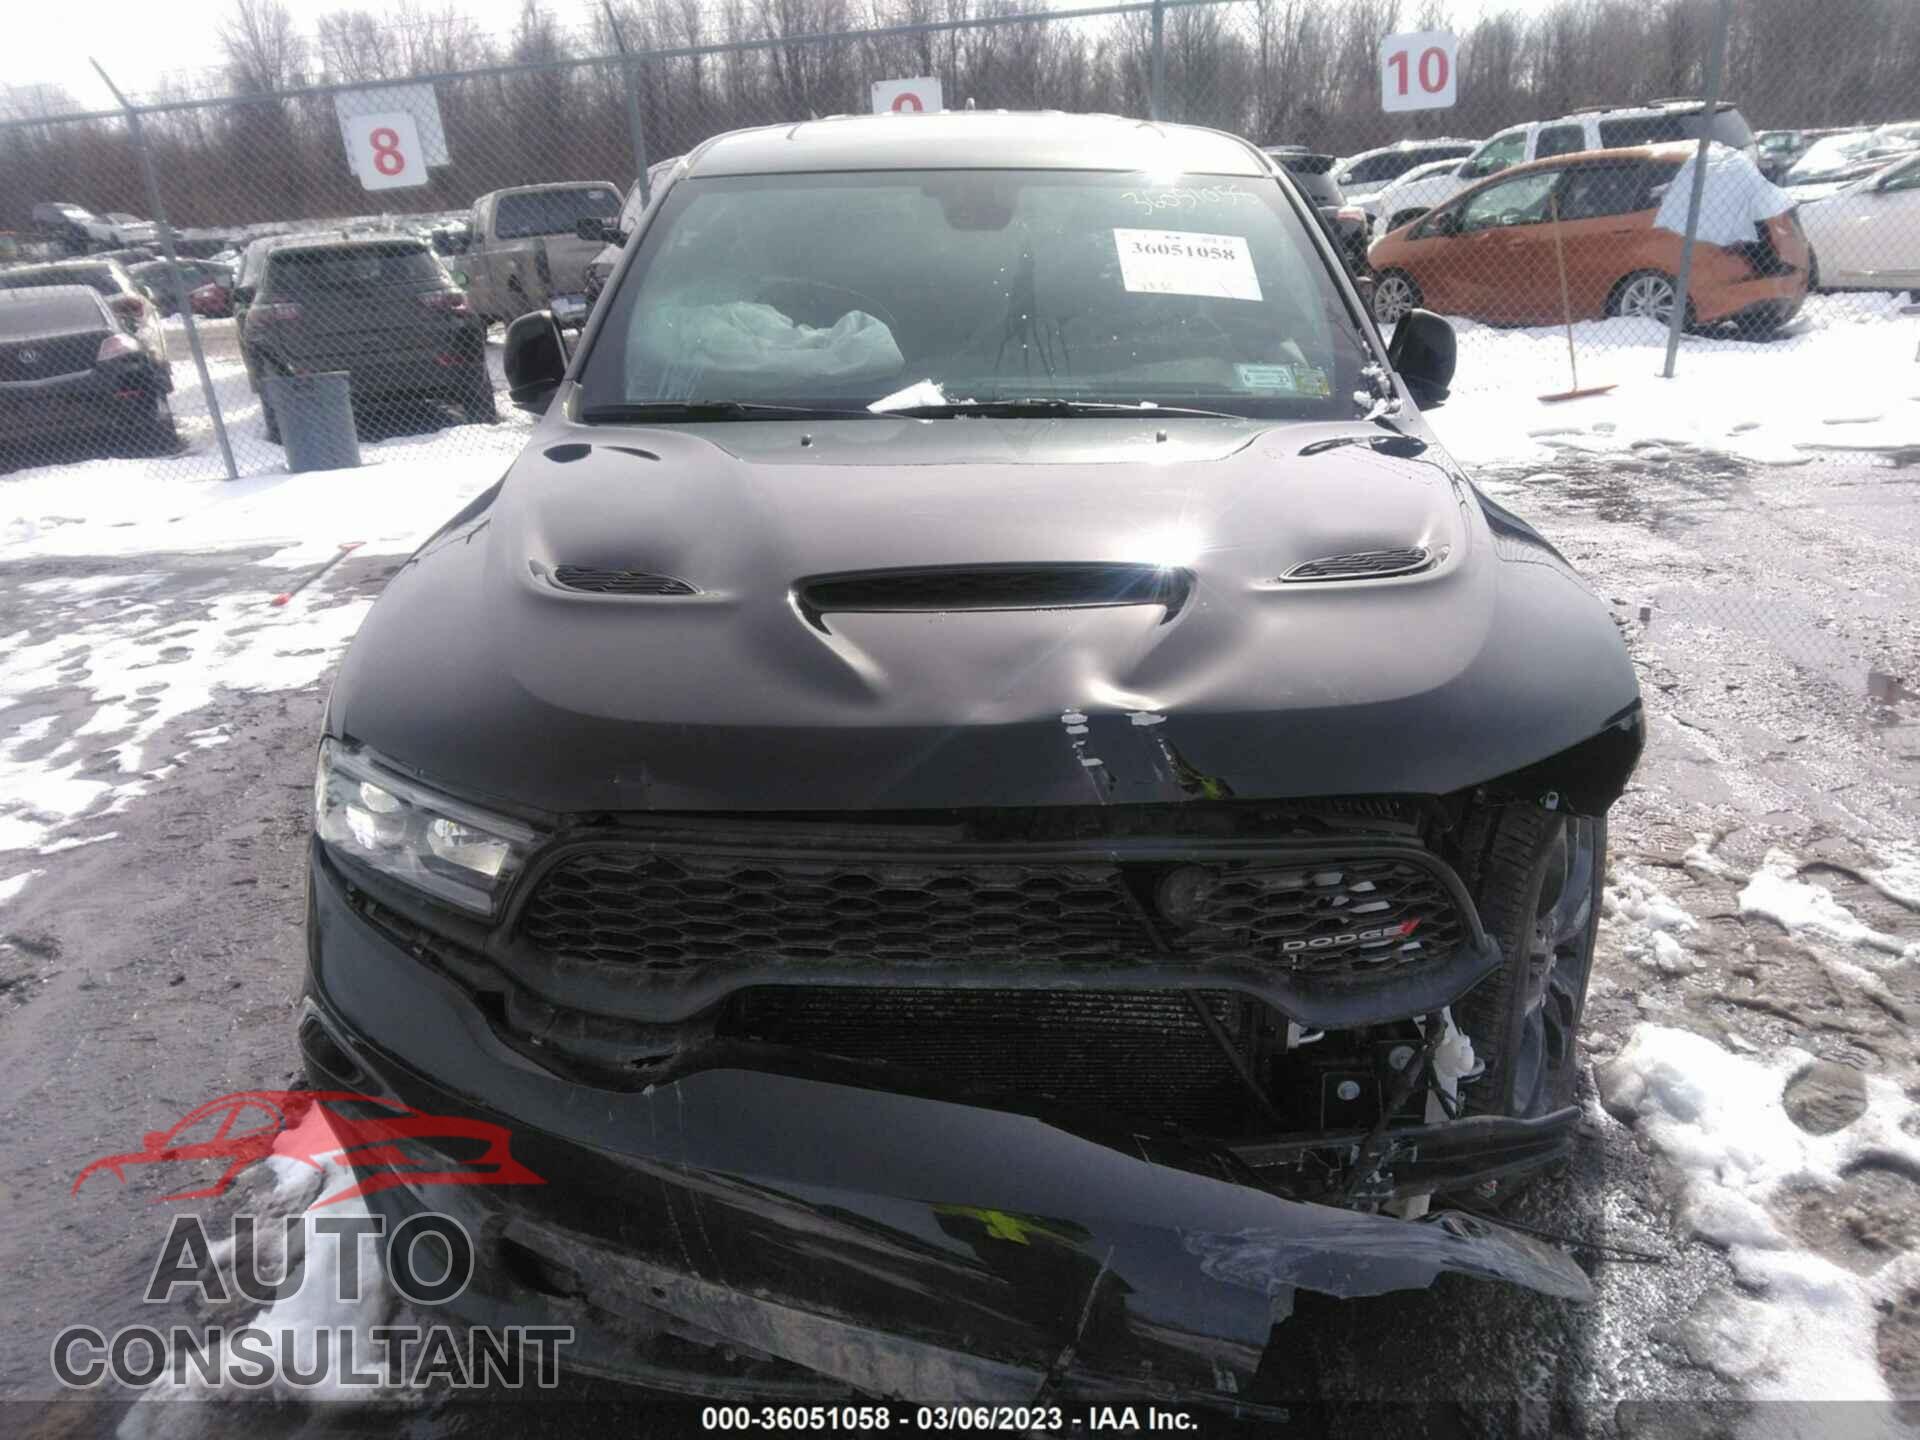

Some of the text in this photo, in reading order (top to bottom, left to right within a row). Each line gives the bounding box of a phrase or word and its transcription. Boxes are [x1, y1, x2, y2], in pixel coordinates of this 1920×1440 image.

[1387, 46, 1449, 96] 10
[369, 127, 405, 176] 8
[1131, 241, 1236, 261] 36051058
[1282, 924, 1403, 952] DODGE
